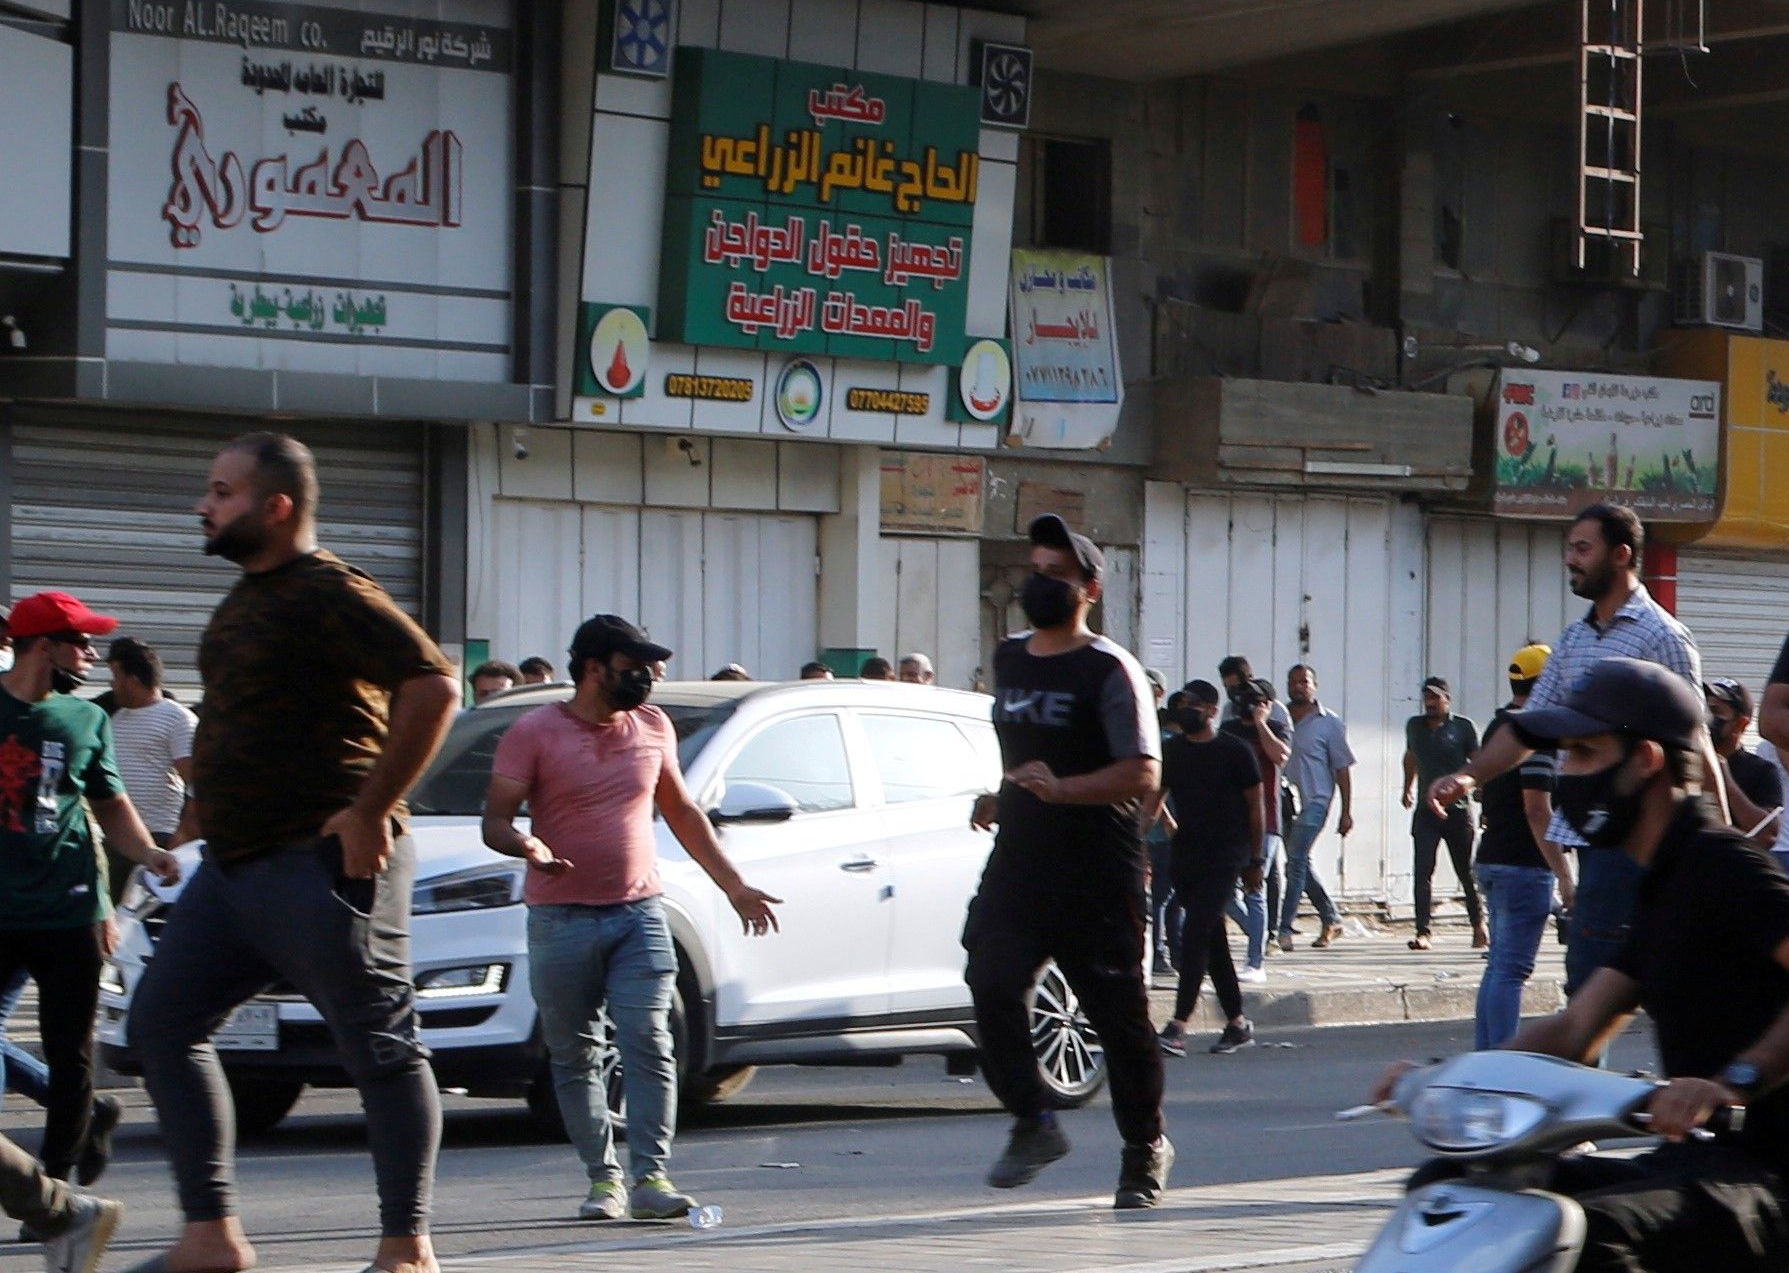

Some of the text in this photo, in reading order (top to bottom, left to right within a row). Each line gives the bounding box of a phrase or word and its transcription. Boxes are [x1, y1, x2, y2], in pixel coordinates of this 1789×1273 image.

[360, 25, 492, 66] شركة نور الرقيم
[282, 106, 328, 136] مكتب
[808, 83, 886, 126] مكتب
[162, 81, 464, 249] المعموري
[702, 125, 980, 213] الحاج غانم الزراعي
[704, 208, 964, 290] تجهيز حقول الدواجن
[727, 281, 936, 353] والمعدات الزراعية
